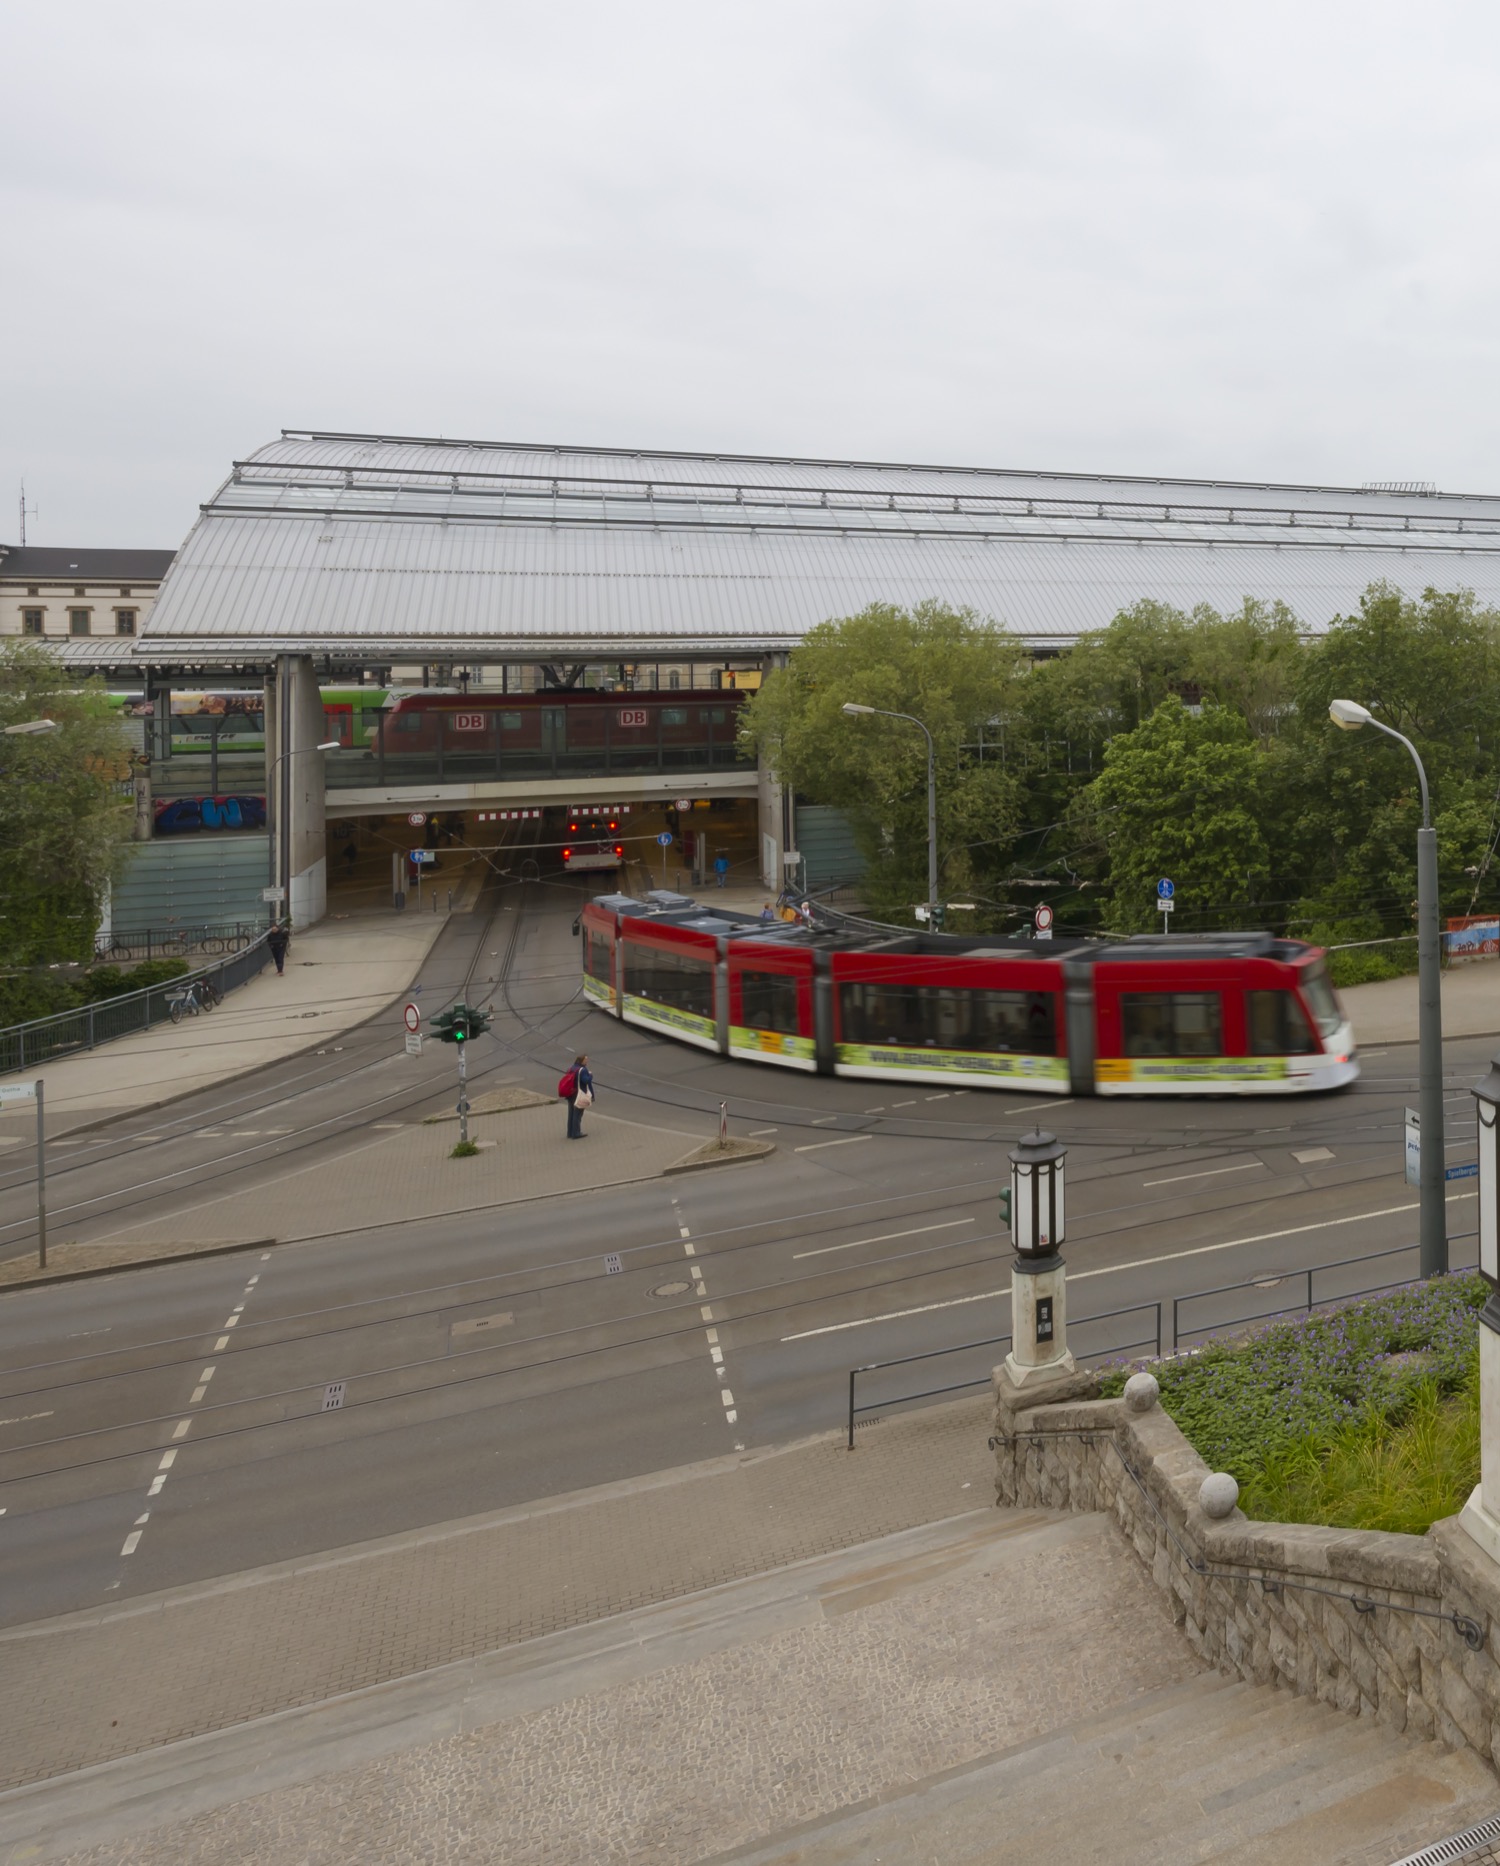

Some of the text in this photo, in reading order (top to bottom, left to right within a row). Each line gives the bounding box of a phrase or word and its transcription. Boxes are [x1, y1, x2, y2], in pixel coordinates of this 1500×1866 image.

[458, 715, 482, 728] DB
[622, 711, 645, 724] DB
[1408, 1141, 1420, 1153] pete
